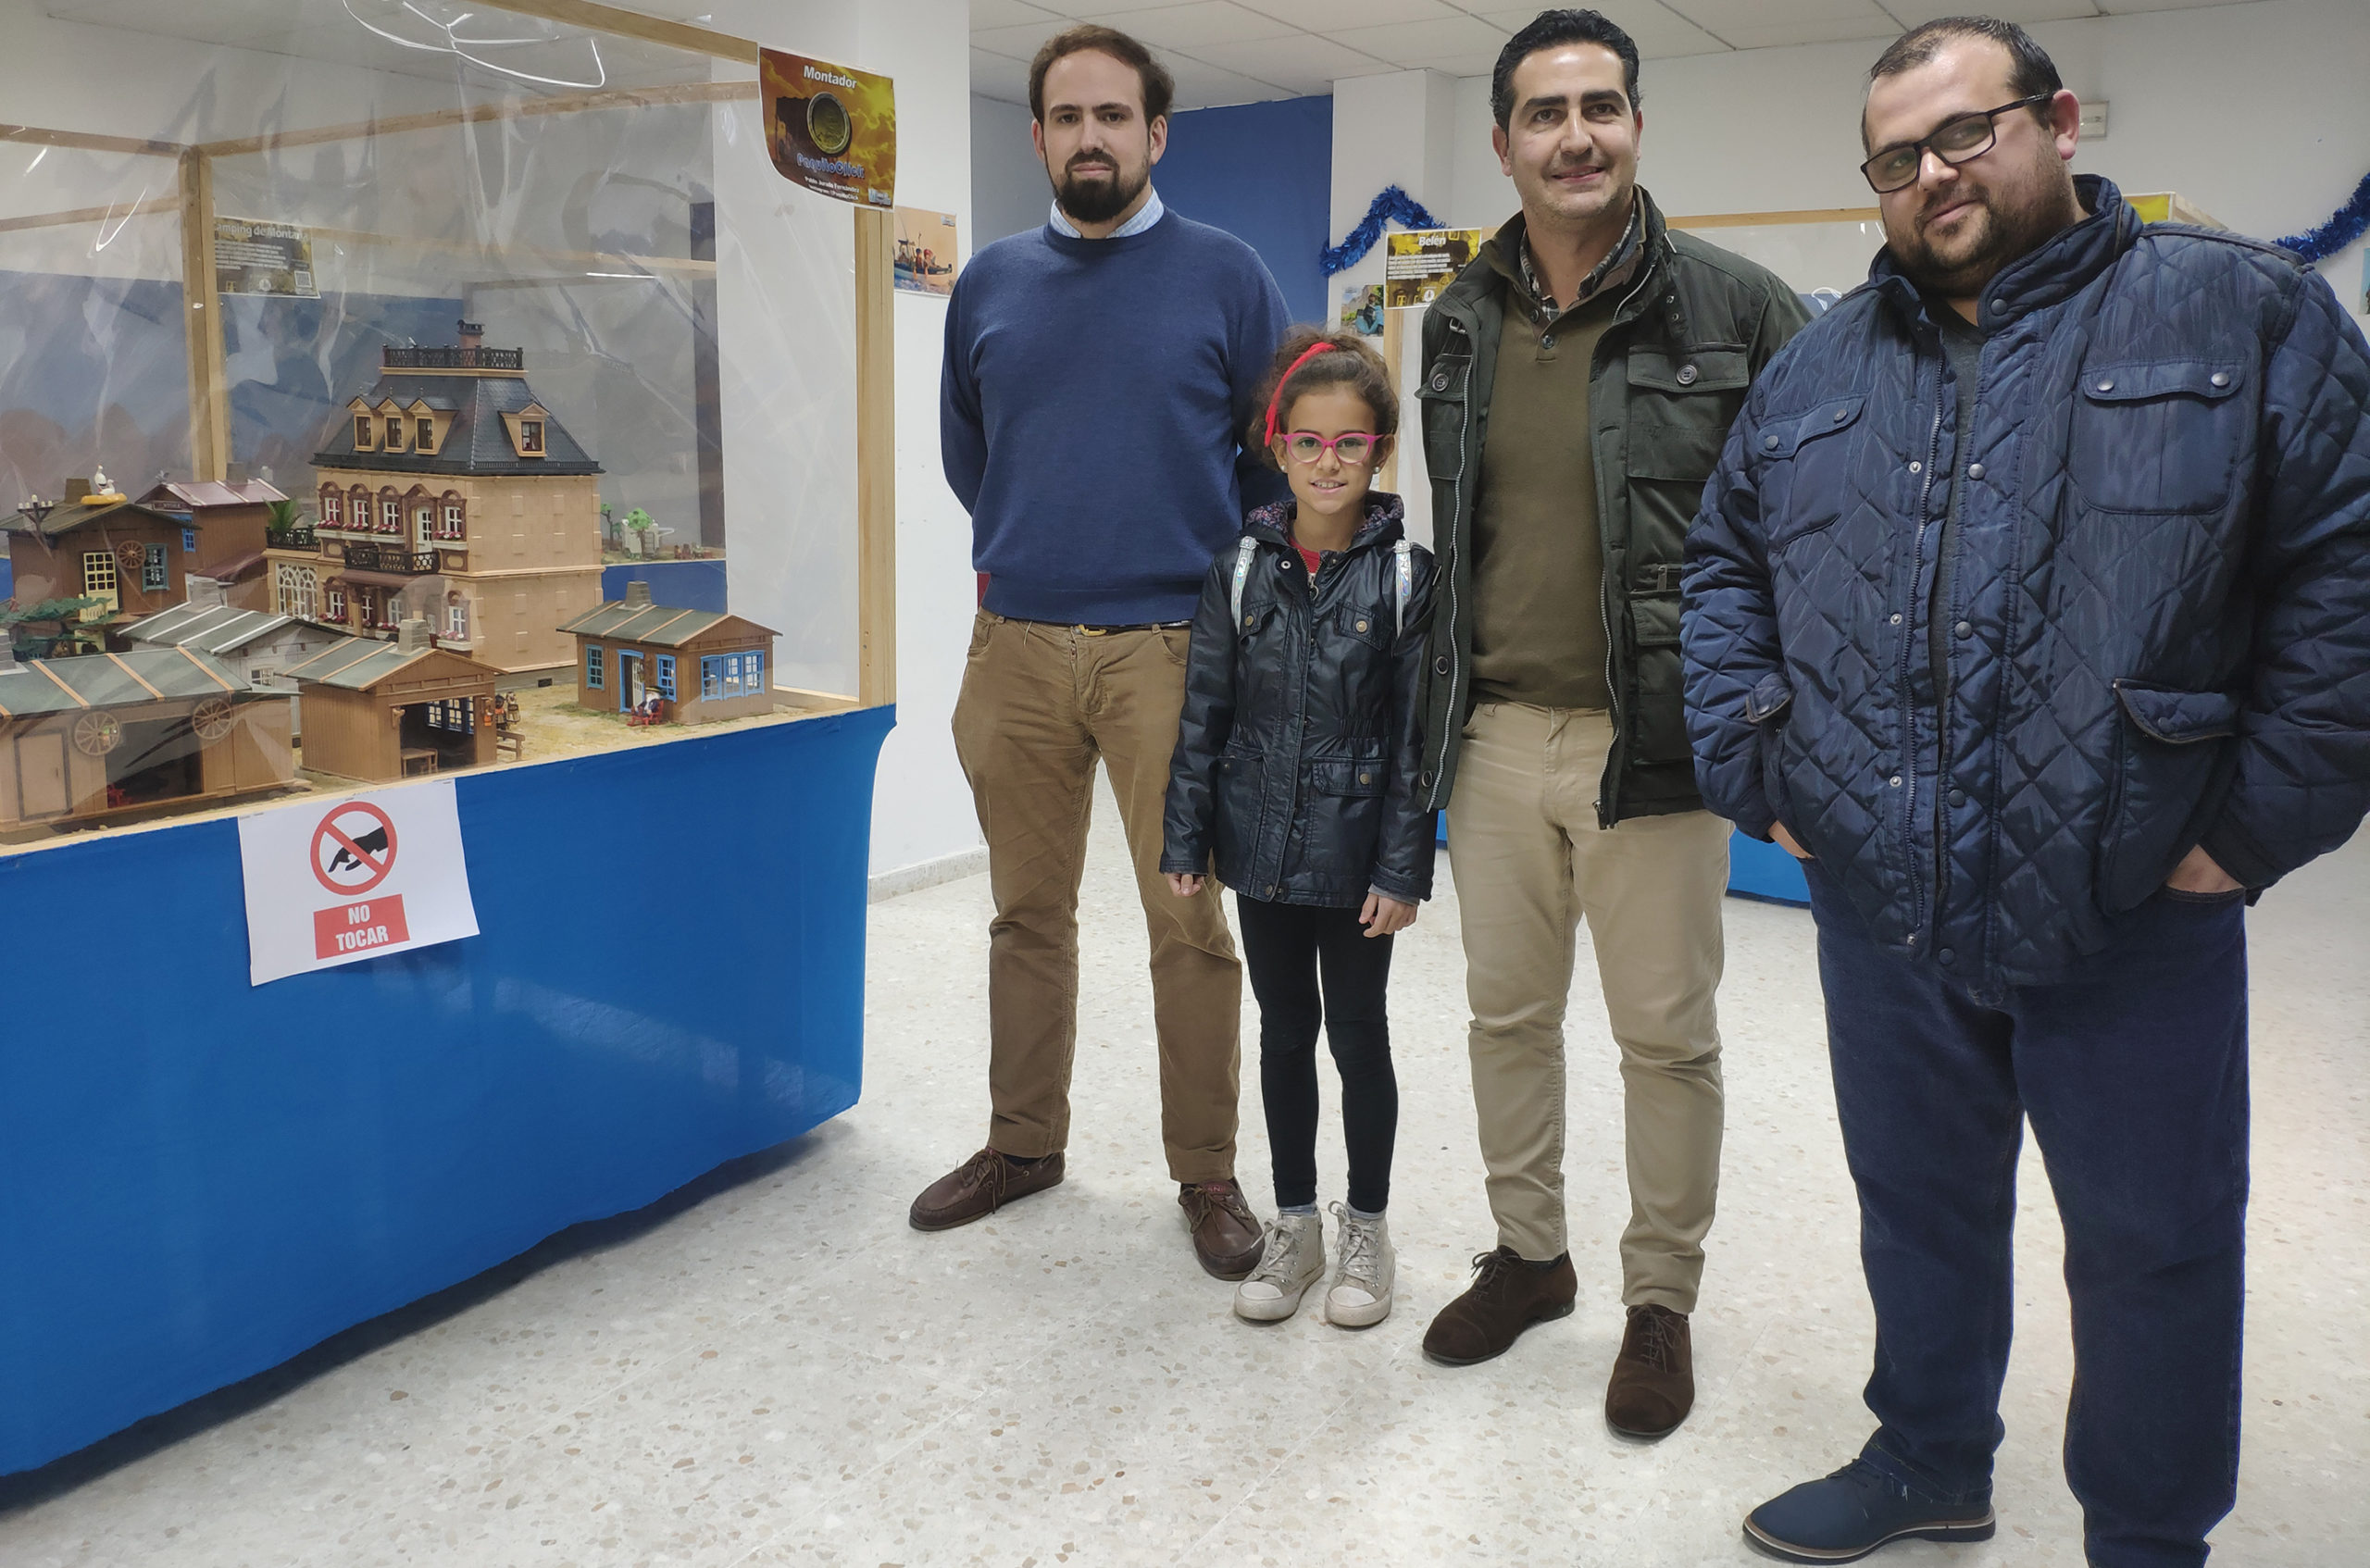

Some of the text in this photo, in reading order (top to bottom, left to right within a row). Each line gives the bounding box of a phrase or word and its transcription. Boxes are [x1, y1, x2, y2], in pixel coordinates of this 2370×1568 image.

[804, 65, 857, 89] Montador
[214, 224, 253, 238] amping
[1418, 235, 1447, 247] Belén
[347, 904, 371, 926] NO
[335, 926, 389, 952] TOCAR
